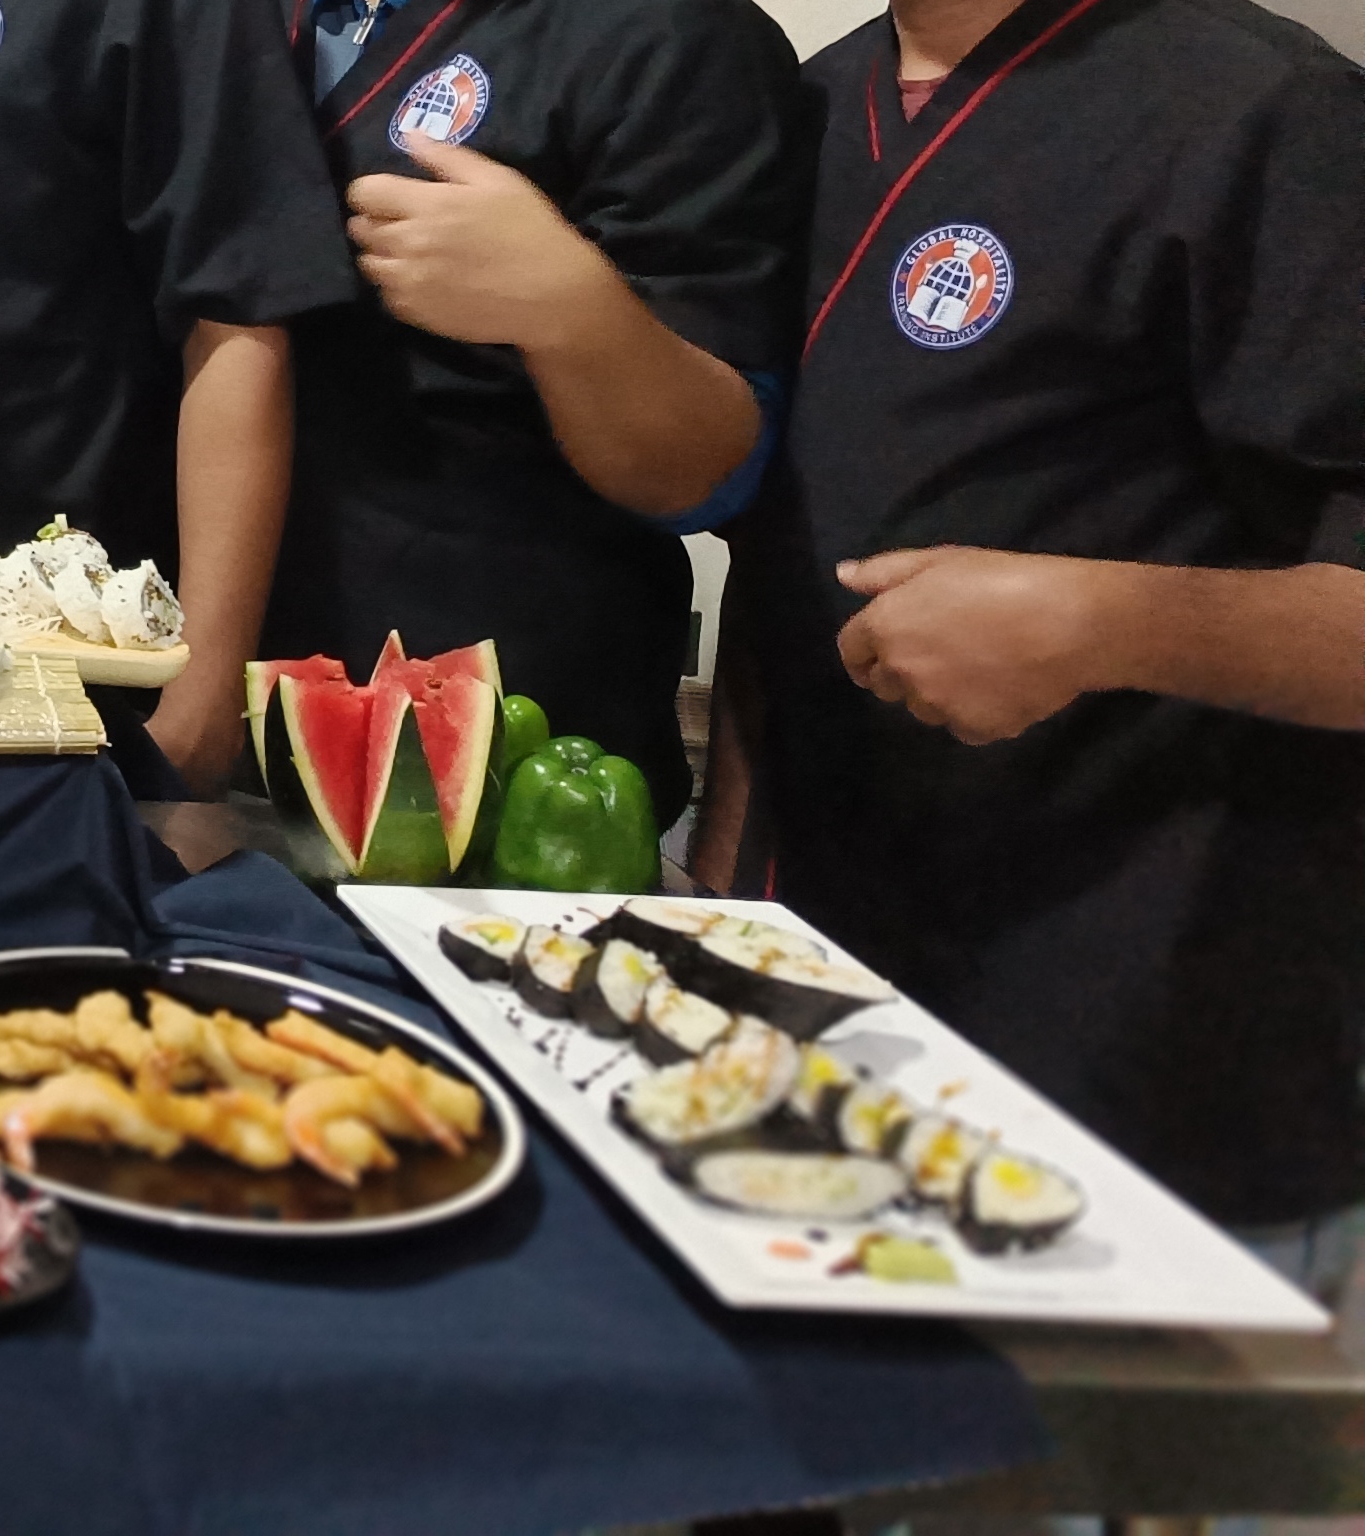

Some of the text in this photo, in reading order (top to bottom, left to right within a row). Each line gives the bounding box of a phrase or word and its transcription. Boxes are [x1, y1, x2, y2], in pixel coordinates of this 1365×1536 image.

[906, 228, 1007, 302] GLOBAL HOSPITALITY
[921, 324, 979, 343] INSTITUTE
